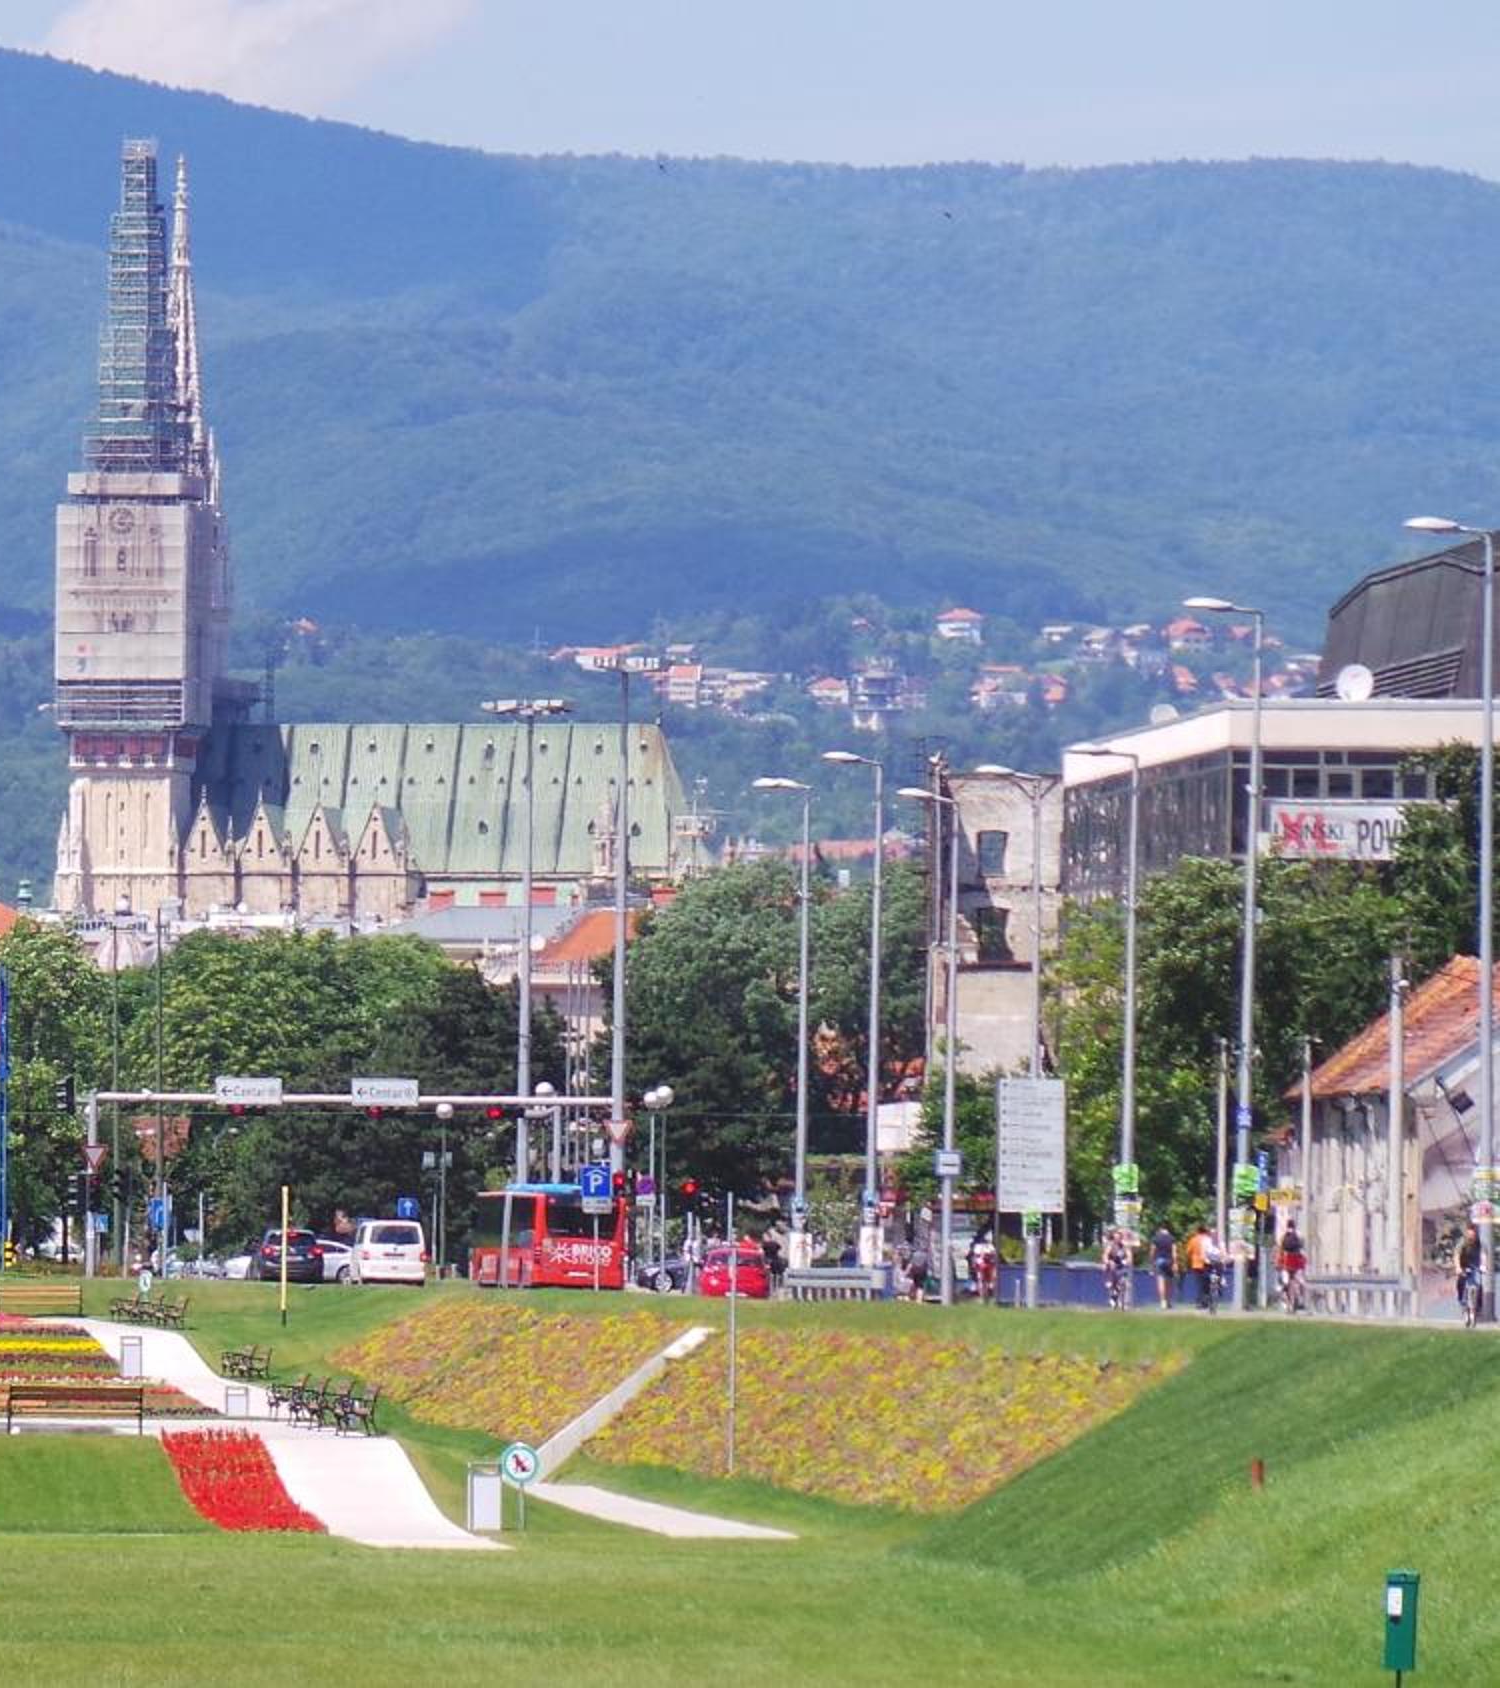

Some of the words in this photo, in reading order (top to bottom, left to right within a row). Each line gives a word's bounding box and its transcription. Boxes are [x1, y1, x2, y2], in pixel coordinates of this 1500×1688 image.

[1357, 818, 1405, 854] POV
[590, 1173, 602, 1193] P
[572, 1243, 612, 1258] BRICO
